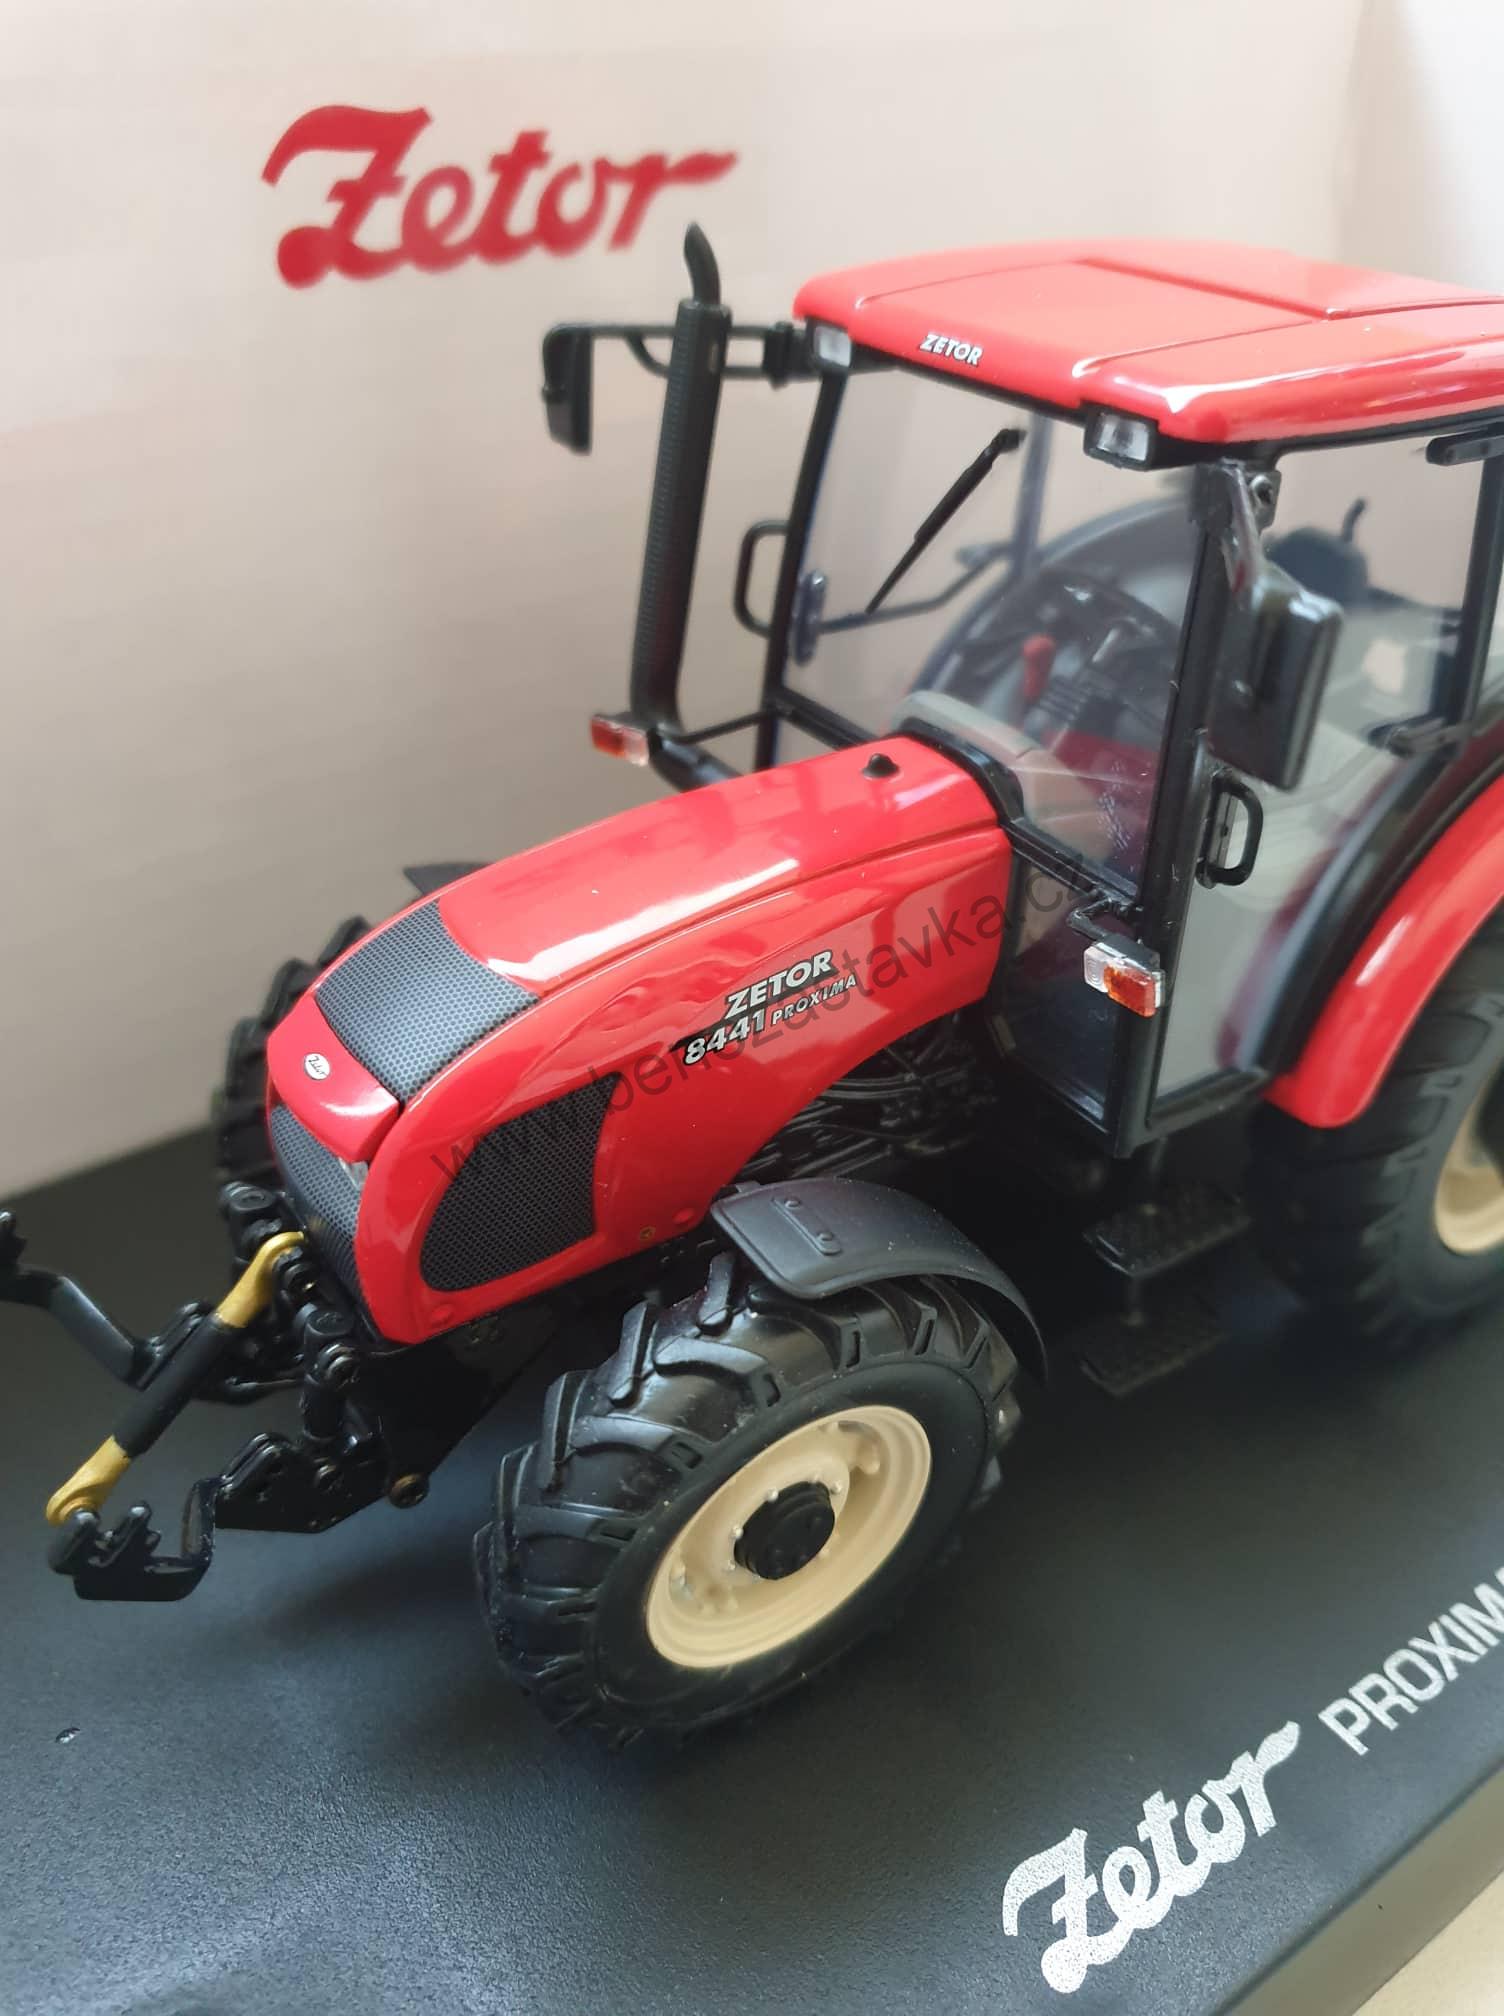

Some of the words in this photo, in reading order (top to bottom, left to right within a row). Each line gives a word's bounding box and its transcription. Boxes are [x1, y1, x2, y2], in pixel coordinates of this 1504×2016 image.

[262, 105, 738, 289] Zetor
[919, 333, 983, 366] ZETOR
[684, 1008, 766, 1065] 8441
[771, 973, 858, 1026] PROXIMA
[725, 949, 833, 1020] ZETOR
[1317, 1566, 1504, 1756] PROXIM
[1002, 1721, 1301, 1994] Zetor
